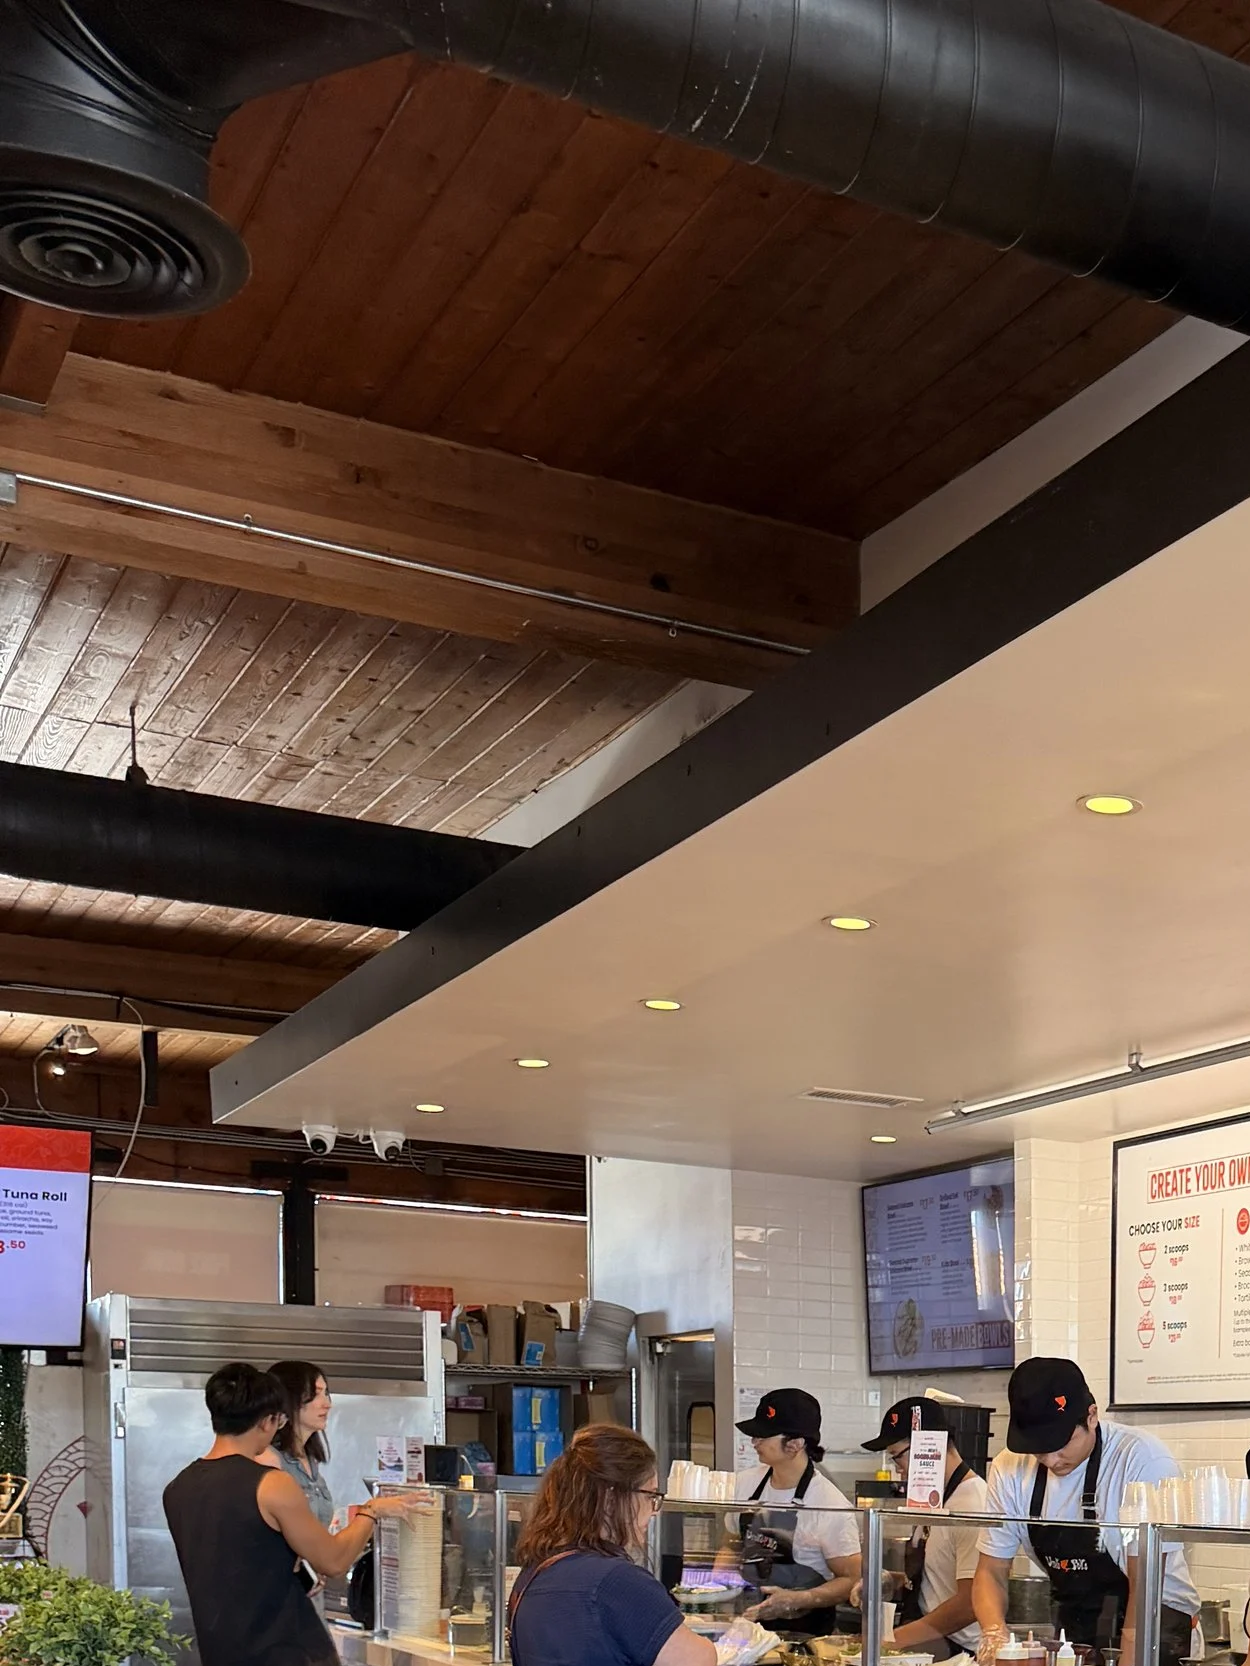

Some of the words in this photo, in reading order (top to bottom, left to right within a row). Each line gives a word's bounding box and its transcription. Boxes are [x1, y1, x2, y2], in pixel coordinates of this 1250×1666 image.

[1150, 1167, 1191, 1200] CREATE
[1195, 1159, 1225, 1192] YOUR
[2, 1189, 38, 1200] Tuna
[42, 1192, 66, 1201] Roll
[1129, 1221, 1160, 1237] CHOOSE
[1162, 1218, 1182, 1232] YOUR
[1185, 1215, 1200, 1229] SIZE
[932, 1324, 975, 1350] PRE-MADE
[977, 1322, 1010, 1348] BOWLS
